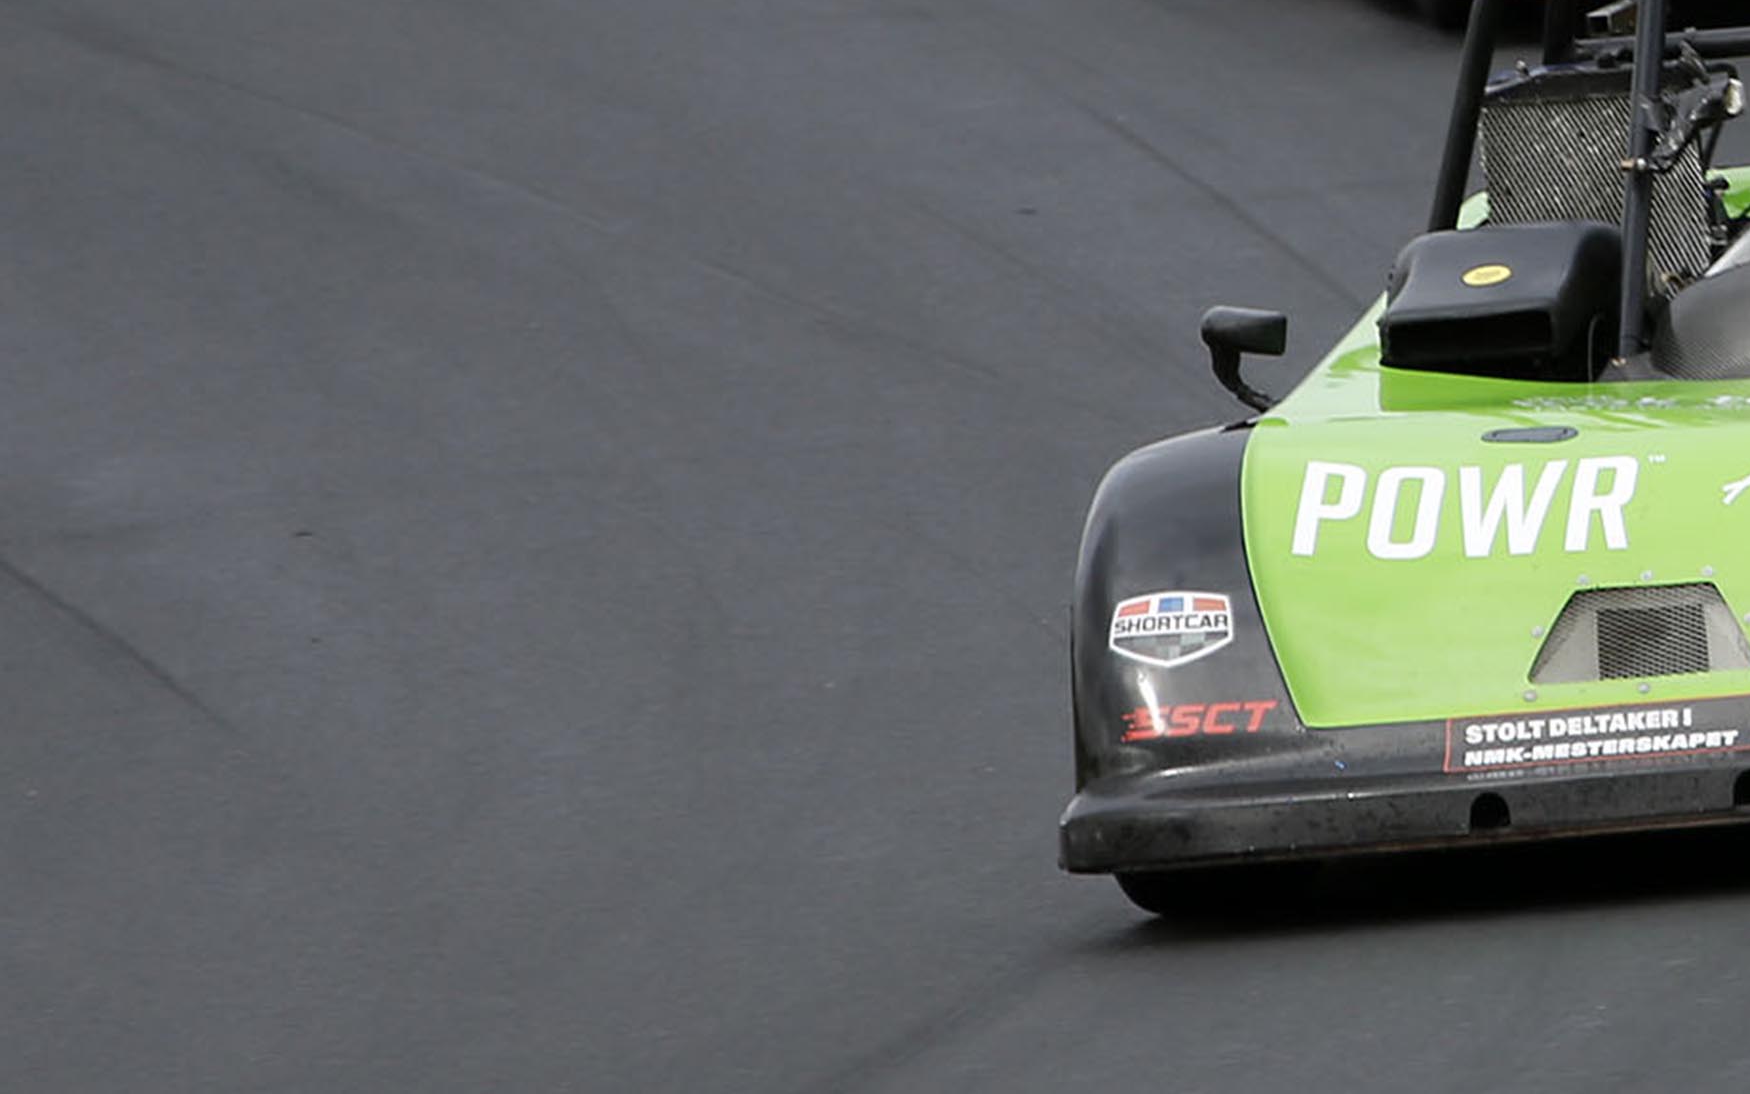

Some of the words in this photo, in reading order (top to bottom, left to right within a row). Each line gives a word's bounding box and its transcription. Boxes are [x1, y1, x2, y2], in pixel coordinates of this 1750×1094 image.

[1291, 454, 1640, 560] POWR
[1113, 612, 1229, 636] SHORTCAR
[1465, 718, 1546, 744] STOLT
[1548, 710, 1682, 740] DELTAKER
[1683, 708, 1693, 728] I
[1464, 729, 1739, 767] NMK-MESTERSKAPET
